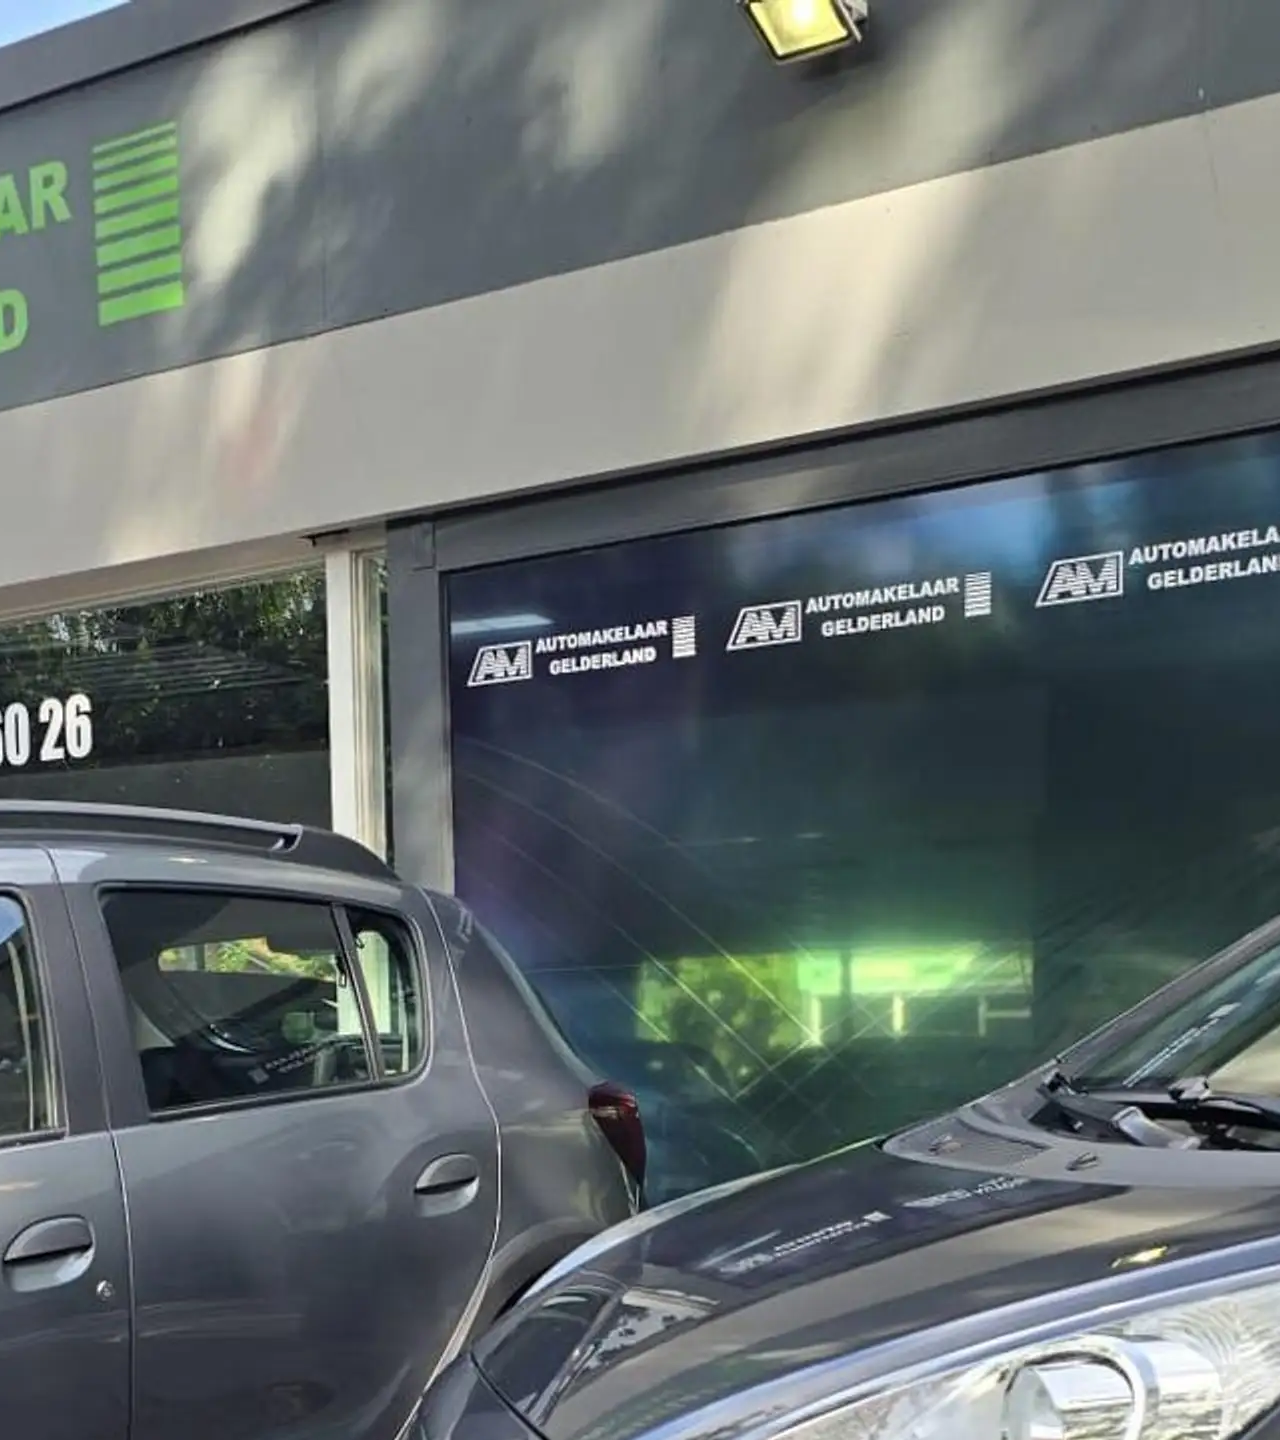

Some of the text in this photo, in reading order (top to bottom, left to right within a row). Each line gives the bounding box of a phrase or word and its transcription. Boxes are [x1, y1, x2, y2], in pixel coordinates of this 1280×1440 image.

[805, 577, 960, 614] AUTOMAKELAAR
[1046, 557, 1118, 600] AM
[535, 620, 669, 653] AUTOMAKELAAR
[735, 605, 797, 645] AM
[821, 605, 946, 638] GELDERLAND
[475, 646, 528, 682] AM
[549, 646, 657, 675] GELDERLAND
[39, 693, 93, 762] 26
